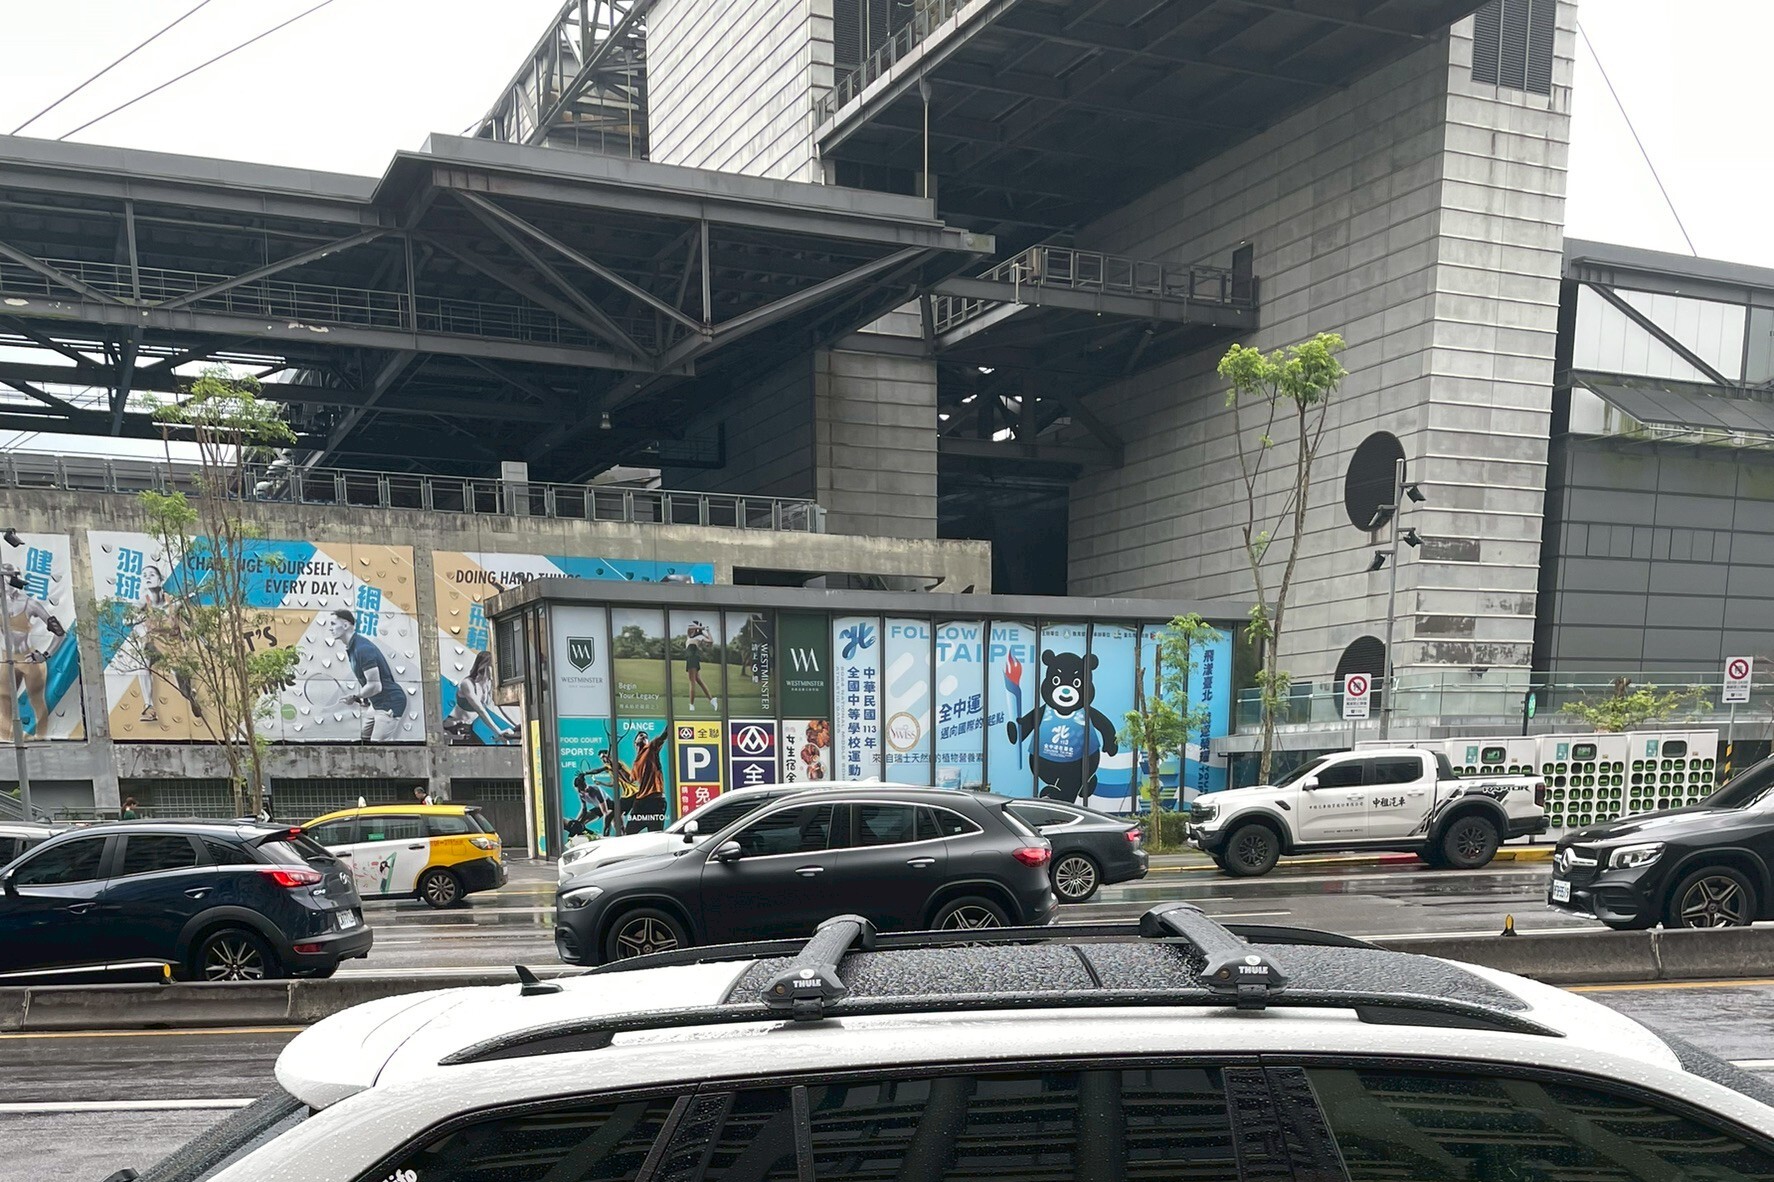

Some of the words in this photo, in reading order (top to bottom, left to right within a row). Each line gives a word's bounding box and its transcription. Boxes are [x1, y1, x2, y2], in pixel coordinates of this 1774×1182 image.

[114, 547, 143, 600] 羽球
[456, 570, 496, 583] DOING
[265, 579, 306, 594] EVERY
[311, 581, 339, 596] DAY.
[891, 626, 978, 640] FOLLOW
[992, 629, 1019, 641] ME
[936, 643, 1035, 663] TAIPEI
[761, 643, 770, 710] WESTMINSTER
[1202, 649, 1214, 702] 飛漾臺北
[618, 682, 637, 691] Begin
[938, 693, 983, 724] 全中運
[623, 722, 655, 730] DANCE
[847, 666, 861, 781] 全國中等學校運動
[698, 728, 719, 739] 全聯
[560, 748, 594, 756] SPORTS
[687, 747, 711, 779] P
[743, 763, 765, 784] 全
[1238, 966, 1269, 974] THULE
[793, 979, 822, 988] THULE
